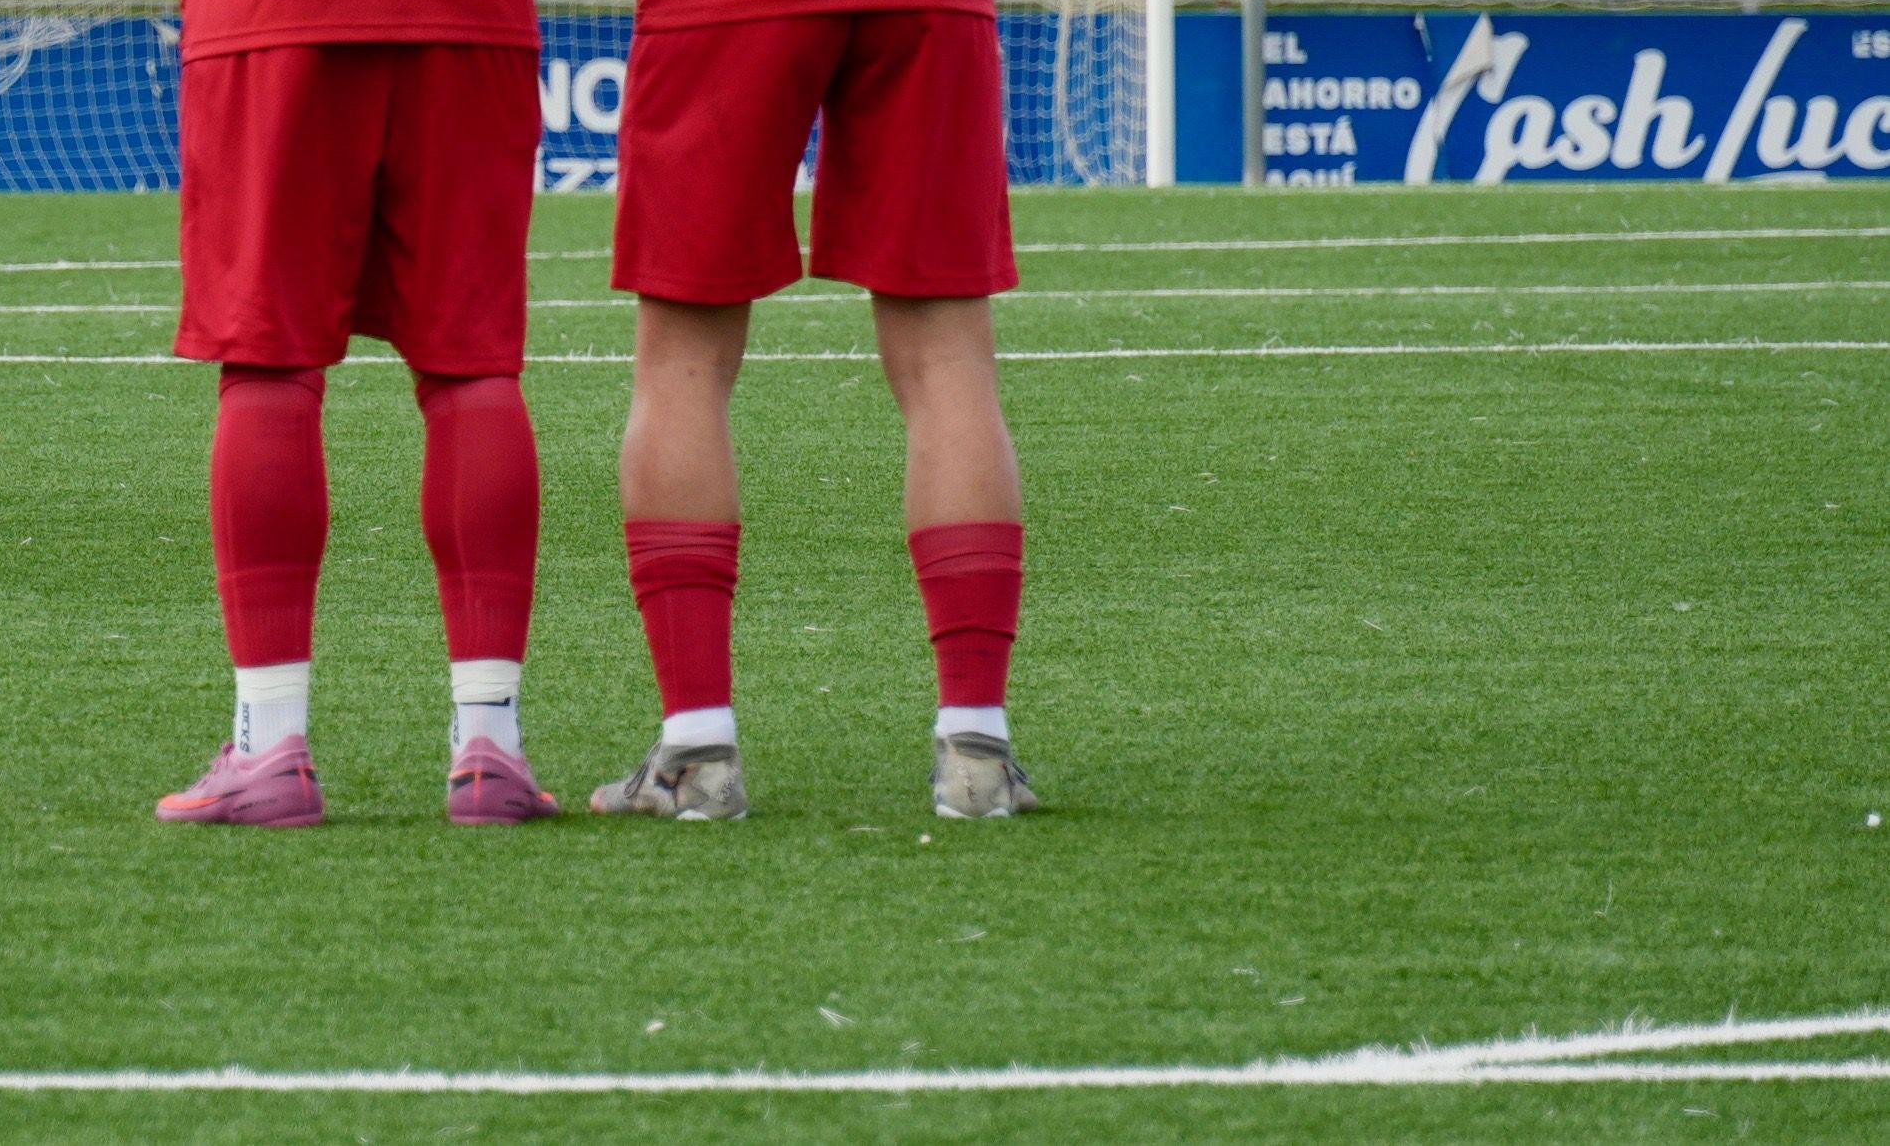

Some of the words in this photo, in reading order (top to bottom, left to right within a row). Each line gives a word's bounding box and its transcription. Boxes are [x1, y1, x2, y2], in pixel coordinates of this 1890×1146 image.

[1263, 31, 1308, 65] EL
[1263, 77, 1422, 110] AHORRO
[1263, 115, 1358, 156] ESTÁ
